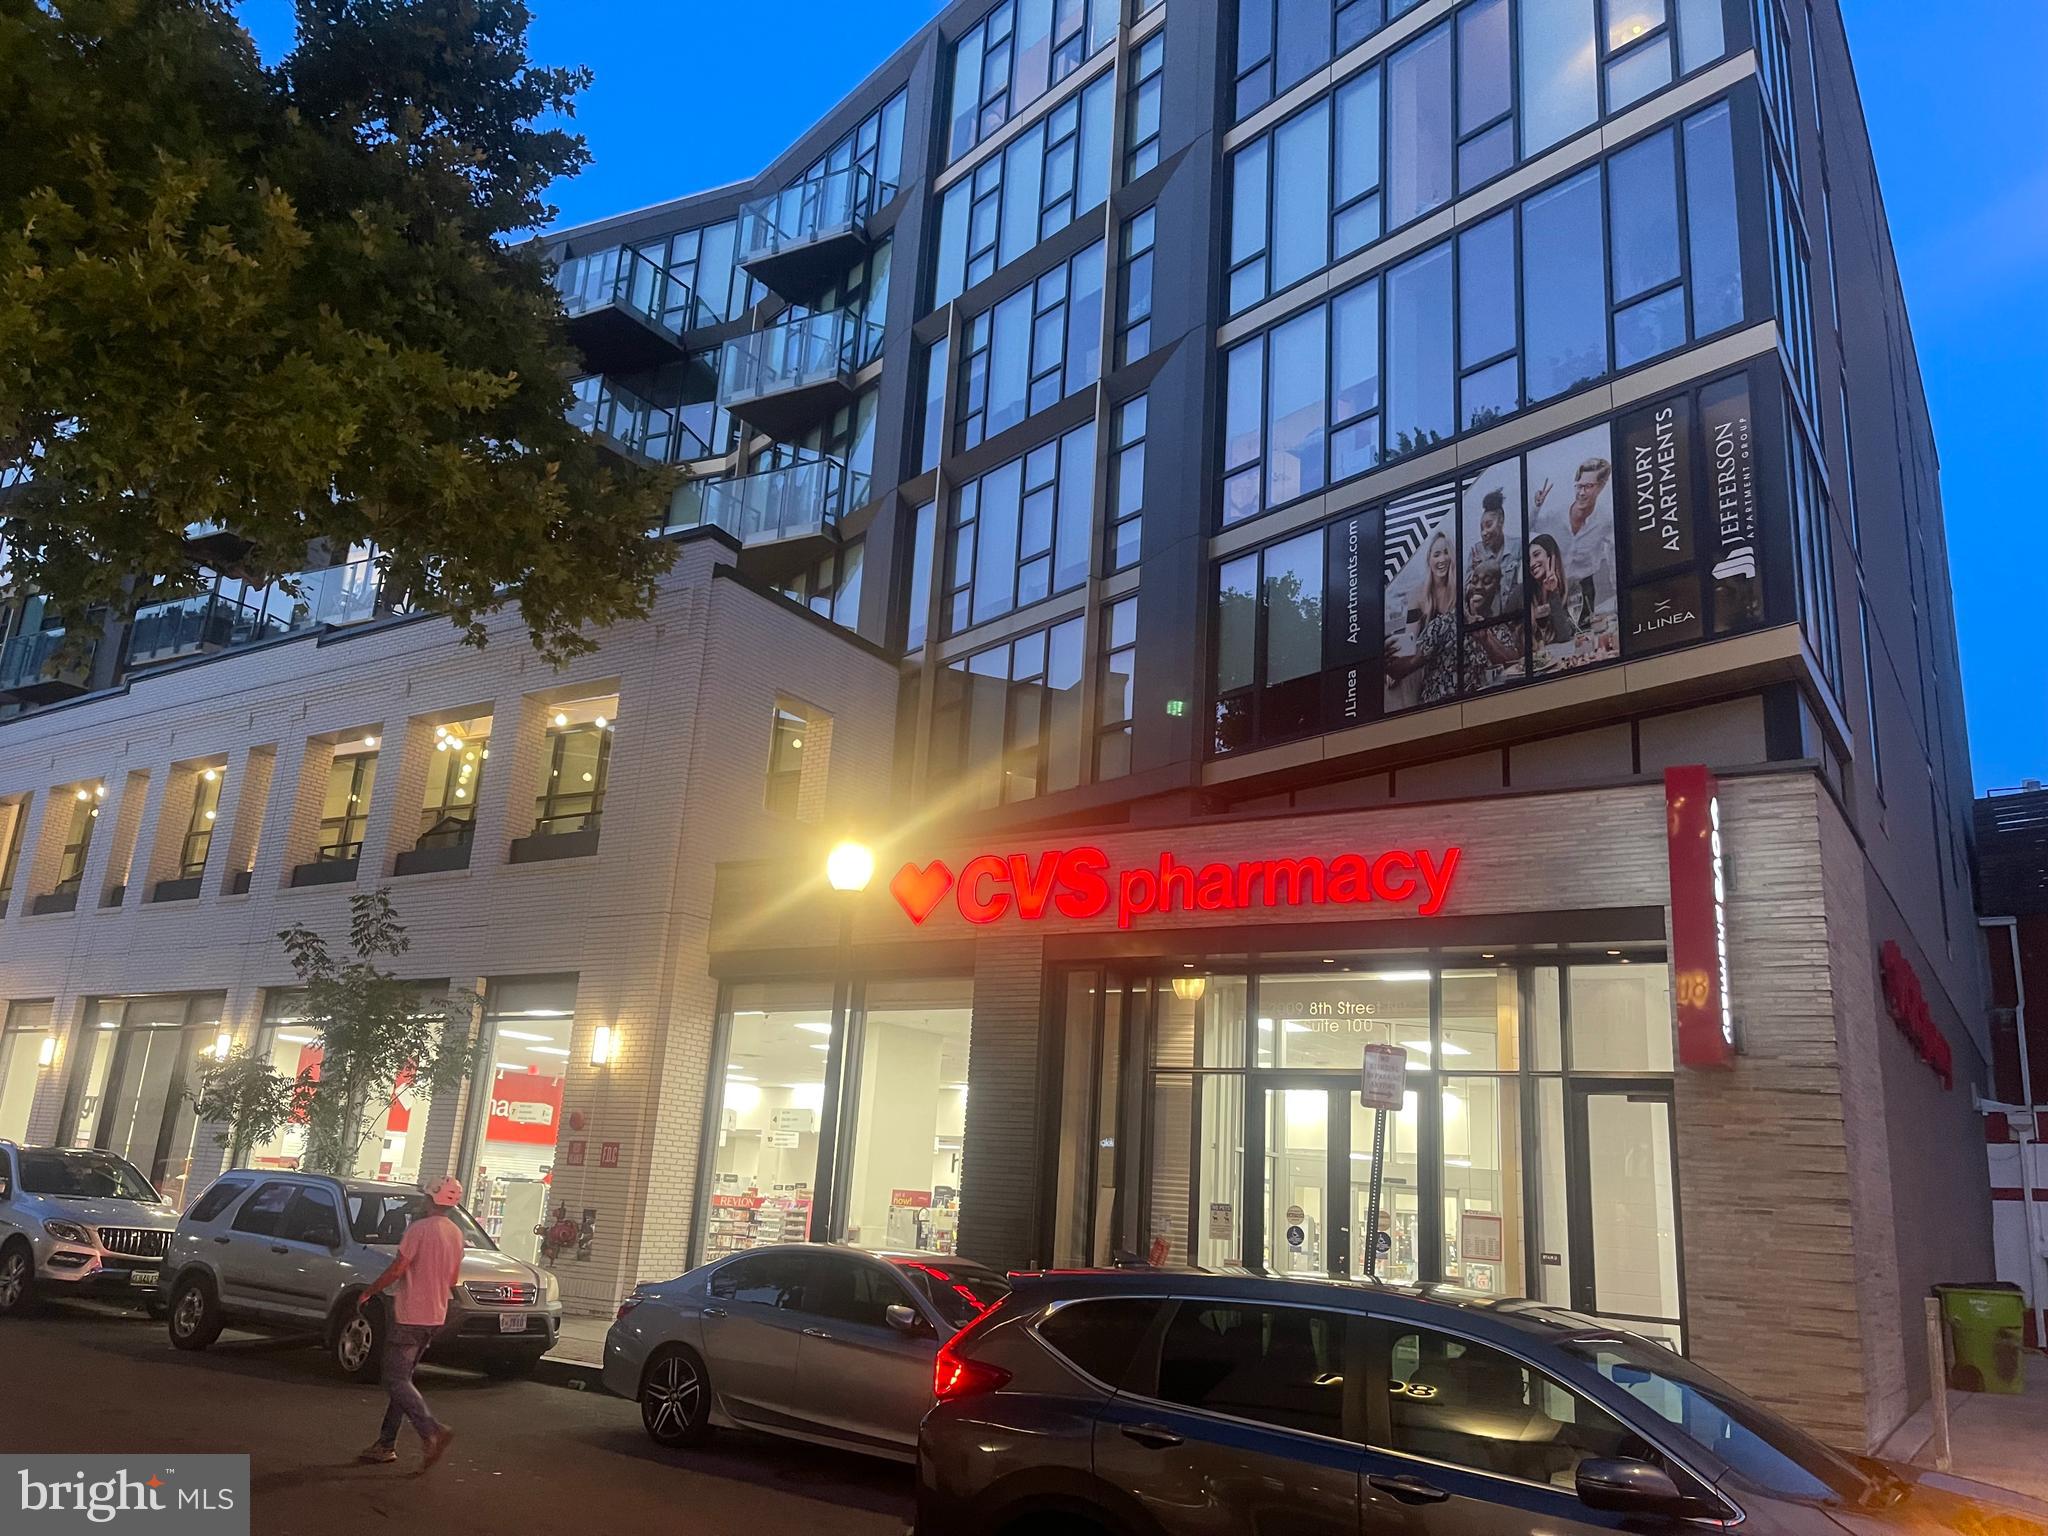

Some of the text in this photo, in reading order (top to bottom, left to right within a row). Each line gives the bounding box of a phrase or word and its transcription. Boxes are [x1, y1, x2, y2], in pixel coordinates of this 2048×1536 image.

[1635, 446, 1656, 532] LUXURY
[1656, 407, 1680, 551] APARTMENTS
[1715, 421, 1746, 546] JEFFERSON
[1739, 417, 1755, 539] APARTMENT GROUP
[1346, 519, 1361, 644] Apartments.com
[957, 847, 1462, 929] CVS pharmacy
[1309, 1002, 1332, 1015] 8th
[1346, 1019, 1373, 1033] 100
[720, 1197, 755, 1207] REVLON
